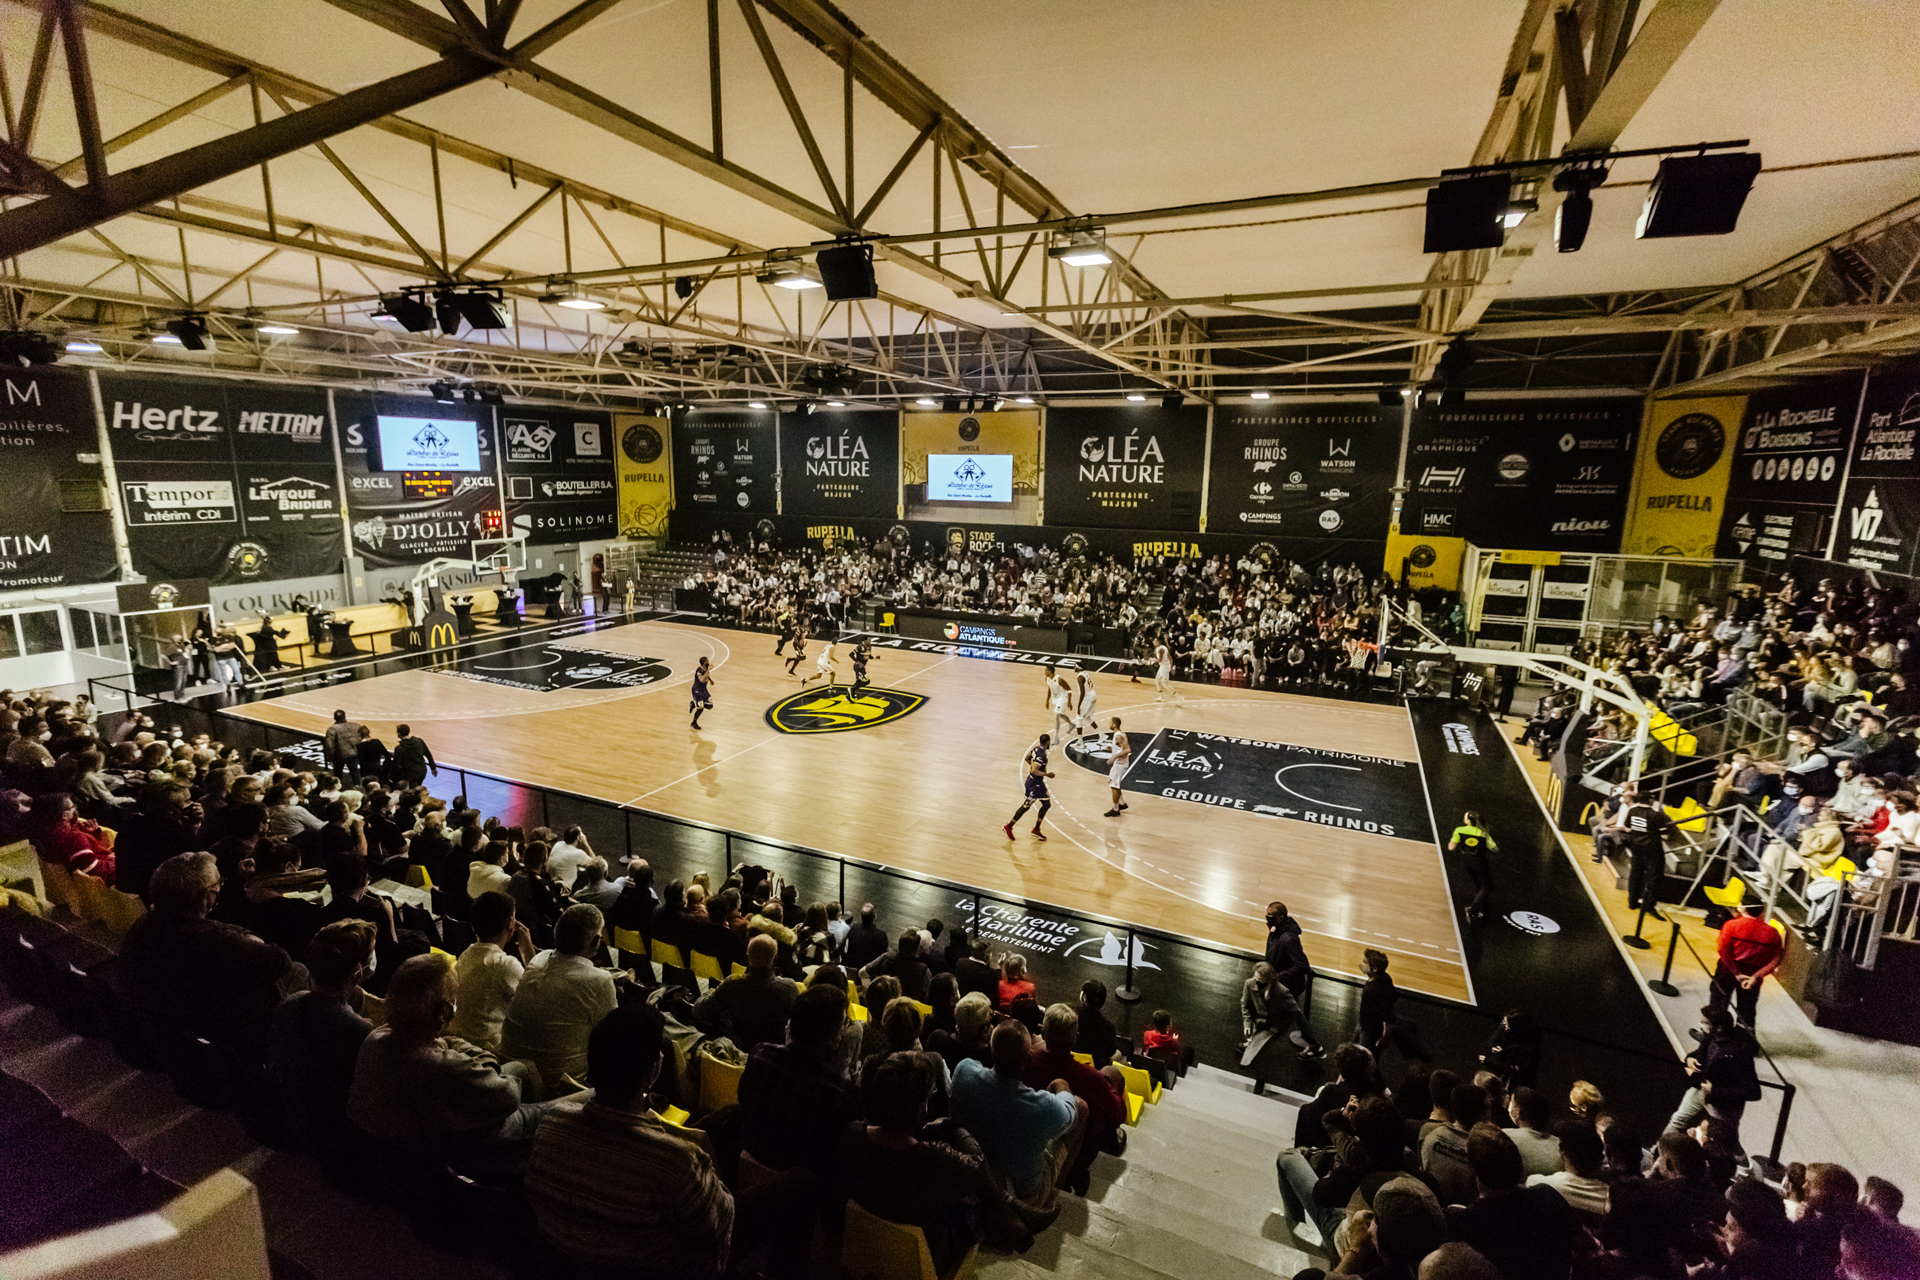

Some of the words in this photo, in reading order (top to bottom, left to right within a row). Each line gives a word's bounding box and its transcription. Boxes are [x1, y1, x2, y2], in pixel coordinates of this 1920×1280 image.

[112, 401, 219, 432] Hertz
[238, 411, 324, 436] METTAM
[1253, 438, 1280, 447] GROUPE
[1244, 447, 1288, 460] RHINOS
[806, 460, 870, 477] NATURE
[1079, 464, 1165, 483] NATURE
[624, 473, 665, 484] RUPELLA
[556, 481, 600, 490] BOUTEILLER
[1091, 491, 1149, 499] PARTENAIRE
[279, 499, 332, 511] BRIDIER
[1646, 495, 1712, 512] RUPELLA
[144, 510, 191, 522] Intérim
[196, 509, 222, 520] CDI
[431, 510, 464, 518] ARTISAN
[1247, 512, 1282, 520] CAMPINGS
[1424, 513, 1453, 525] HMC
[537, 514, 614, 528] SOLINOME
[392, 520, 471, 541] D'JOLLY
[806, 525, 855, 541] RUPELLA
[969, 531, 996, 542] STADE
[1132, 541, 1200, 559] RUPELLA
[959, 625, 996, 636] CAMPINGS
[959, 633, 1005, 645] ATLANTIQUE
[1197, 733, 1280, 750] WATSON
[1286, 745, 1407, 768] PATRIMOINE
[1145, 757, 1212, 773] NATURE
[1162, 787, 1247, 810] GROUPE
[1304, 810, 1396, 837] RHINOS
[980, 905, 1080, 936] Charente
